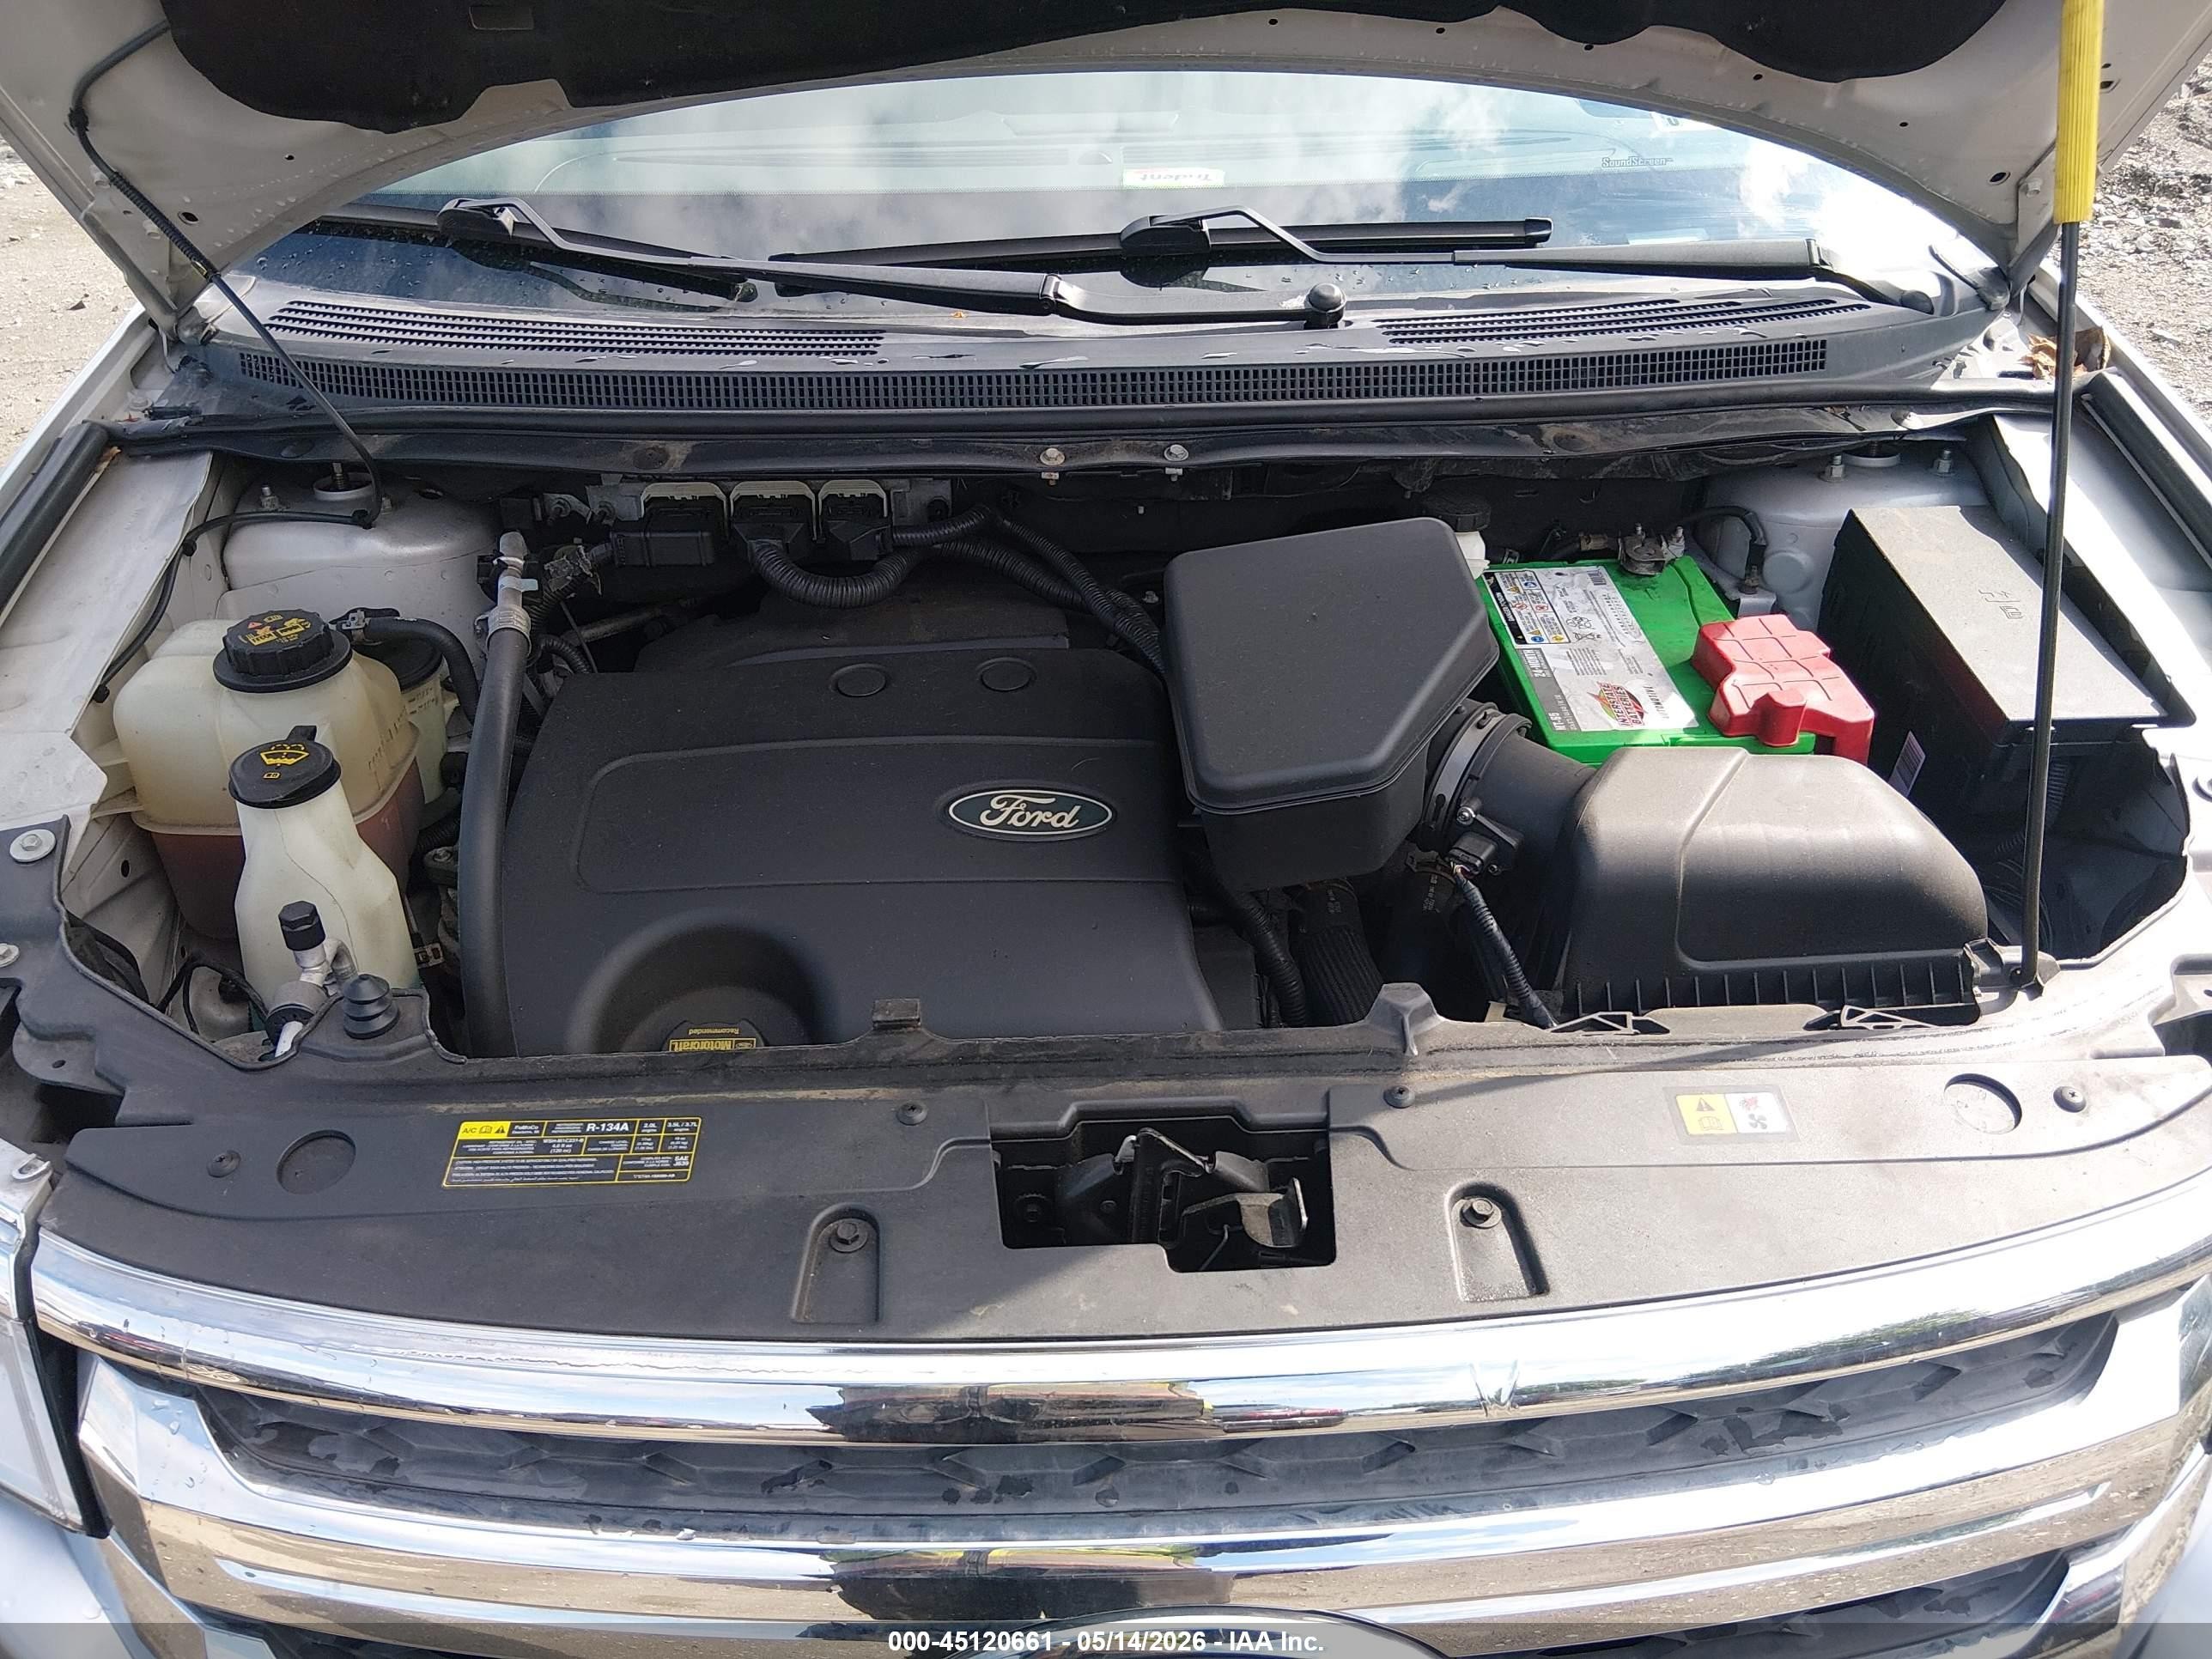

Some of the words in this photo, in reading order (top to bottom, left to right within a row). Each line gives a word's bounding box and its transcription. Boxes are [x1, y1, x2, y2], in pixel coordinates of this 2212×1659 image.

[1601, 156, 1667, 167] SoundScreen
[1601, 683, 1631, 726] INTERSTATE
[1614, 687, 1642, 725] BATTERIES
[979, 794, 1082, 828] Ford
[689, 1027, 739, 1036] Recommended
[672, 1040, 733, 1052] Motorcraft
[586, 1122, 629, 1132] R-134A
